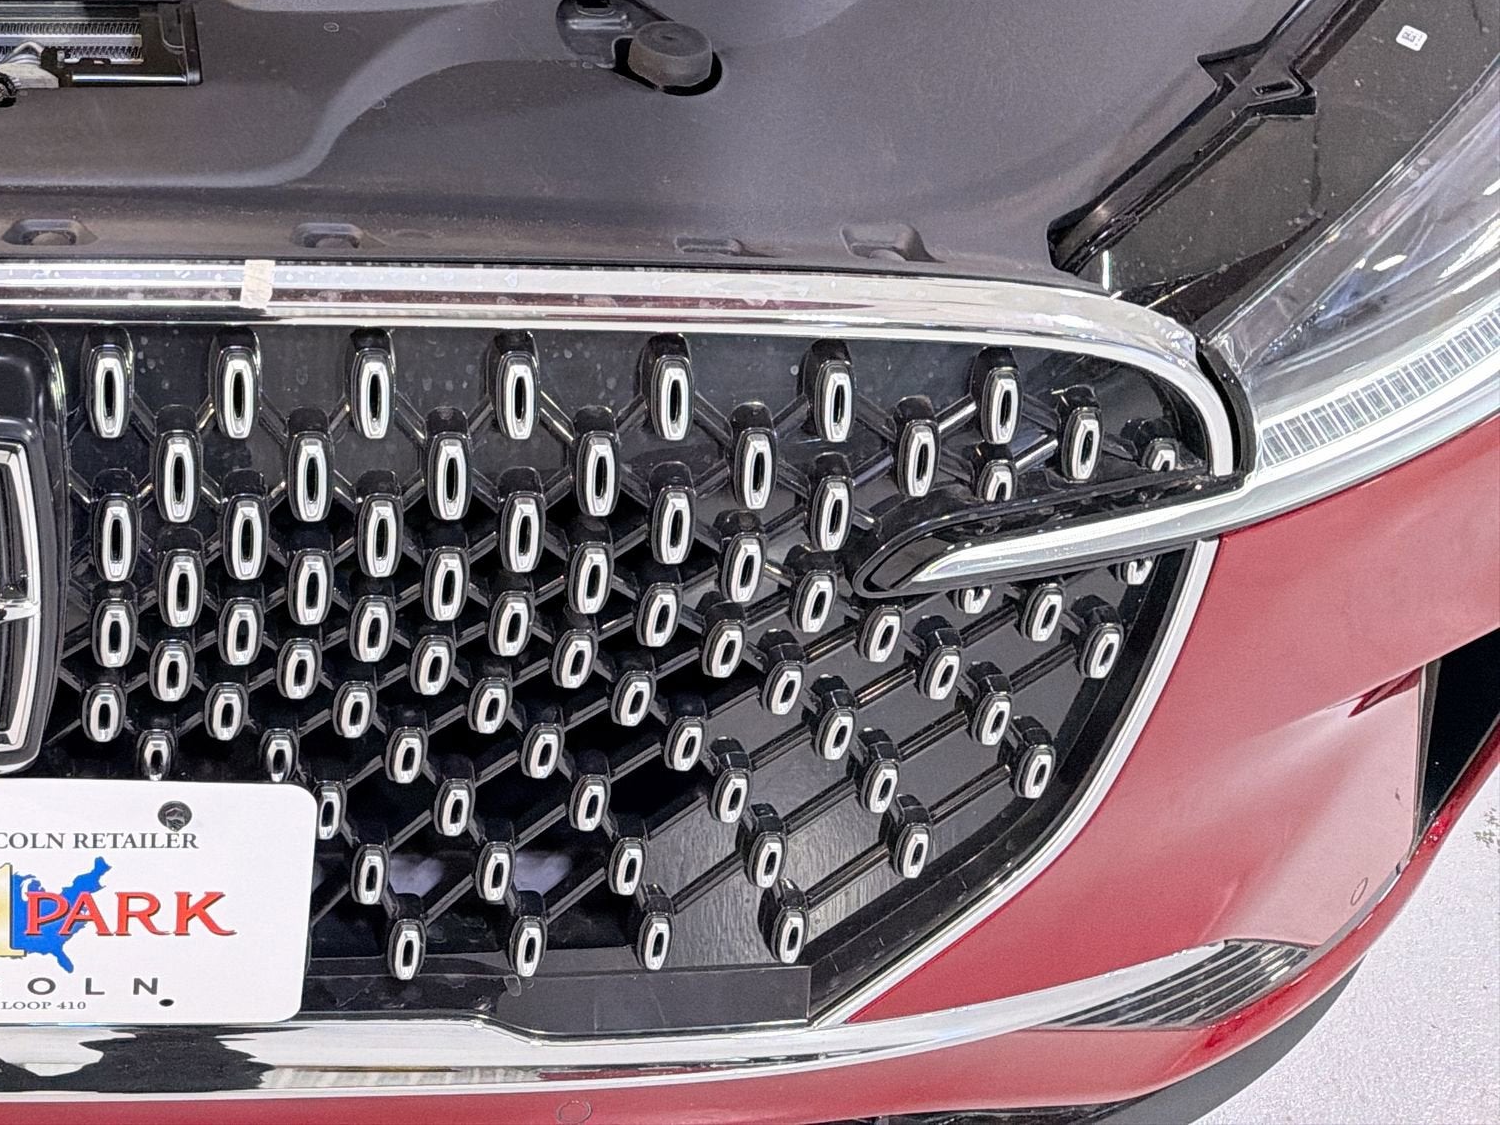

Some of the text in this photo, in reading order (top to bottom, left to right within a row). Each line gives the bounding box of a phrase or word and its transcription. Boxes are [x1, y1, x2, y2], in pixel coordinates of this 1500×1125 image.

[73, 832, 199, 850] RETAILER
[24, 890, 237, 937] PARK
[1, 1000, 52, 1011] LOOP
[56, 1000, 87, 1011] 410
